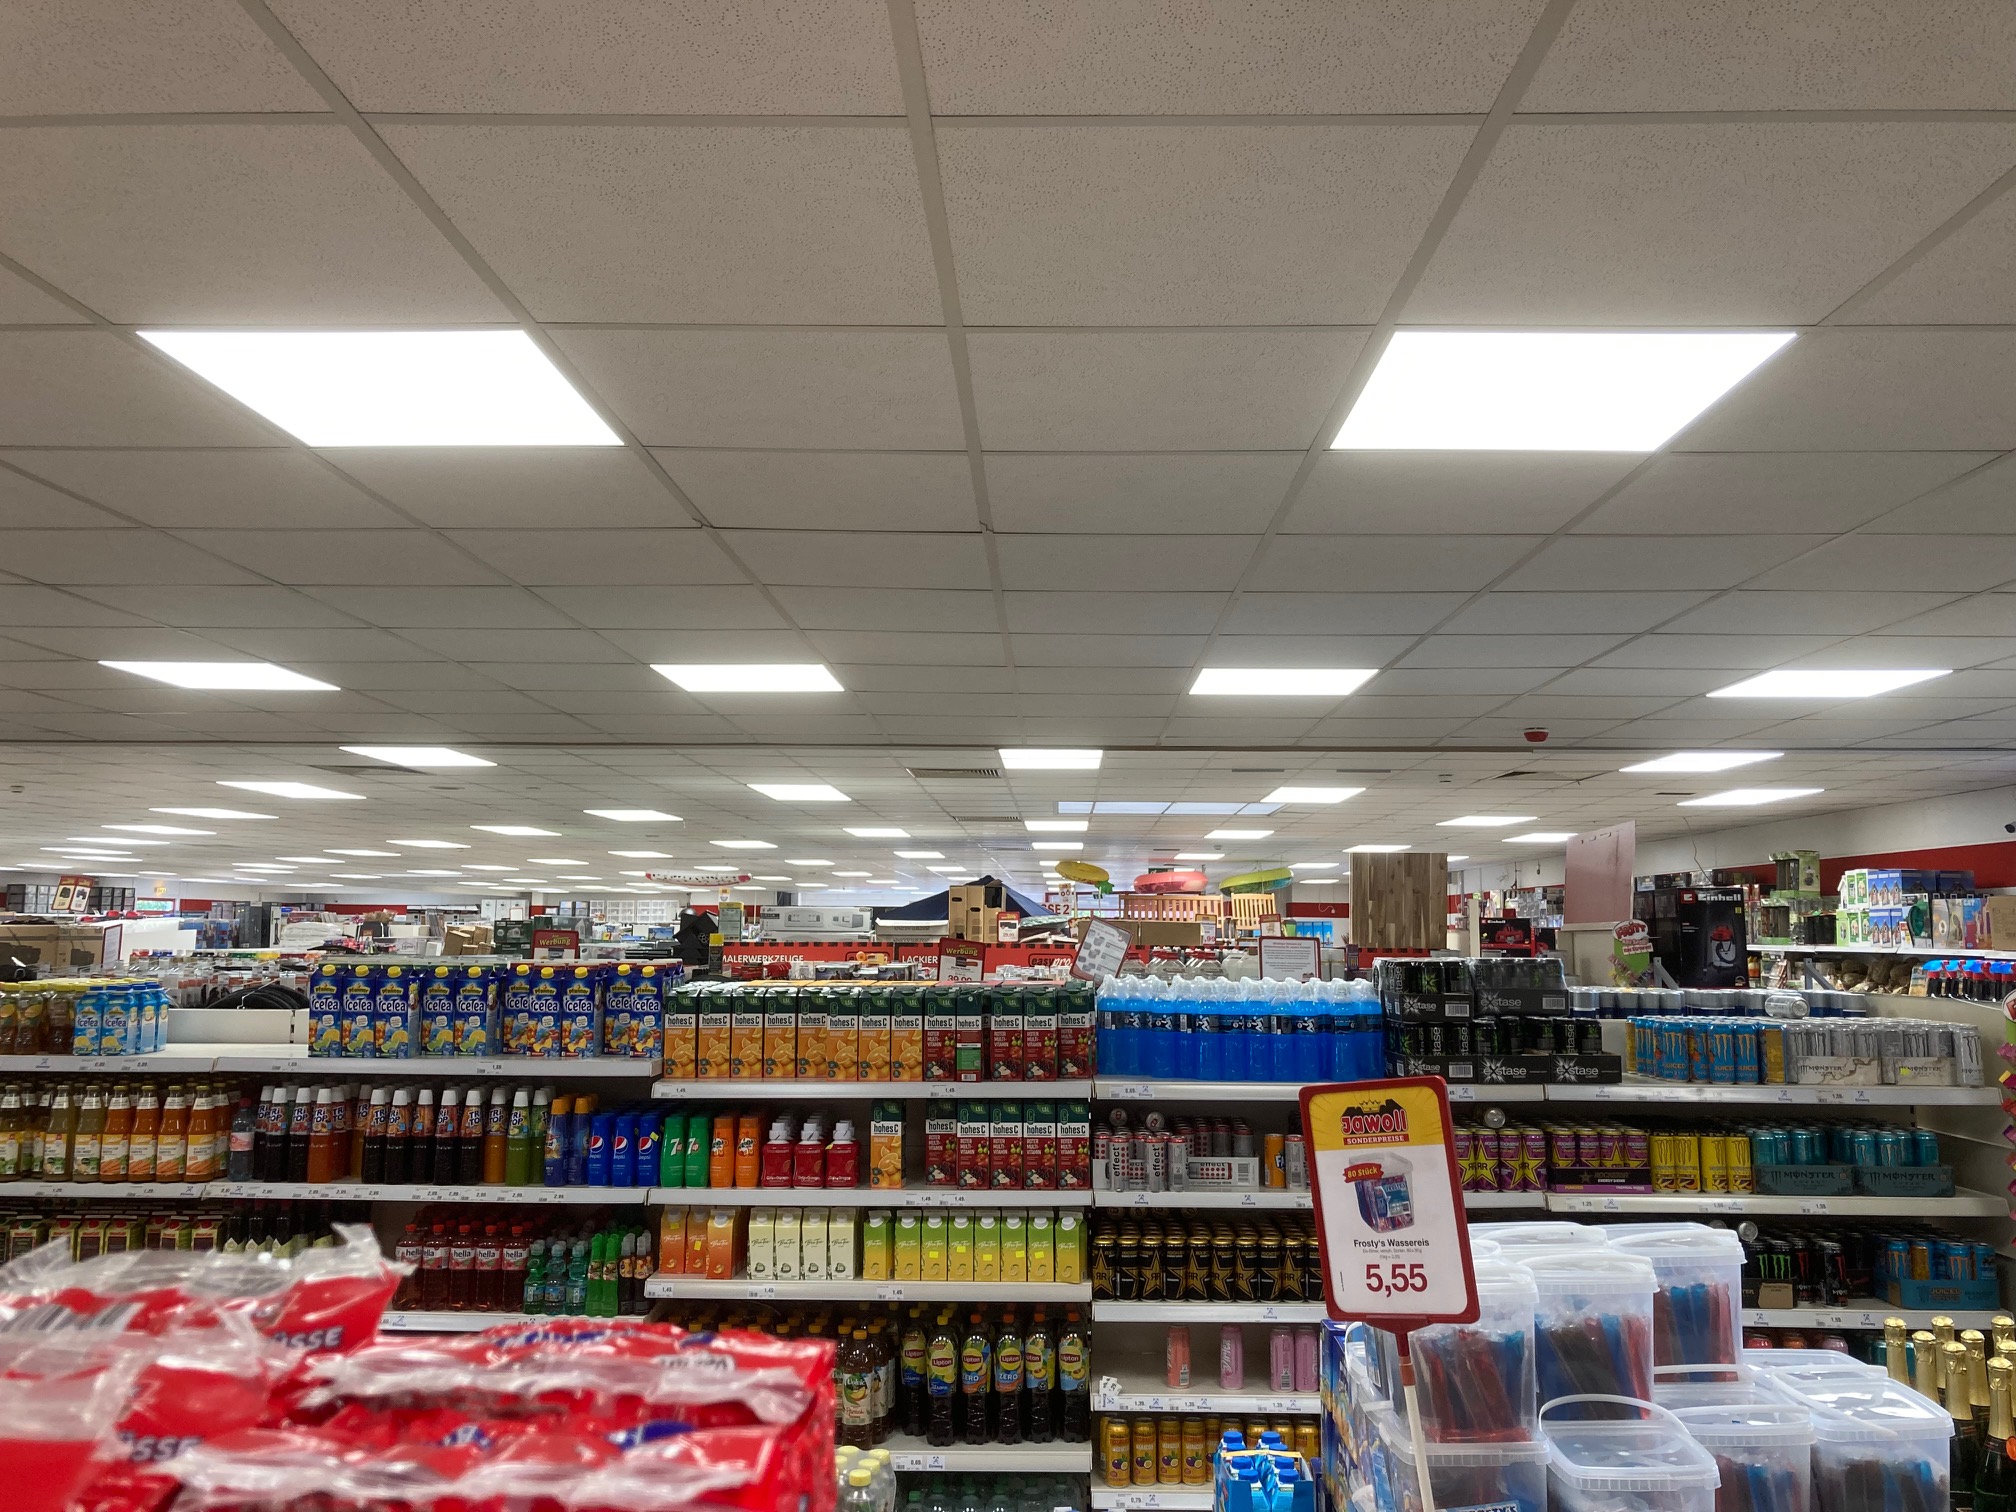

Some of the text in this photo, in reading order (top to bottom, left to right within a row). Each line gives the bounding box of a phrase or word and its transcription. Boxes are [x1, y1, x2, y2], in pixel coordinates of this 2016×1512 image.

[1698, 894, 1742, 902] Einhell
[946, 948, 978, 957] Werbung
[722, 954, 804, 964] MALERWERKZEUGE
[1347, 1135, 1404, 1144] SONDERPREISE
[1358, 1166, 1377, 1176] Stück
[1354, 1238, 1430, 1248] Frosty's Wassereis
[454, 1249, 470, 1258] hella
[478, 1249, 495, 1258] hella
[505, 1249, 522, 1258] hella
[1366, 1264, 1428, 1298] 5,55
[905, 1350, 925, 1358] Lipton
